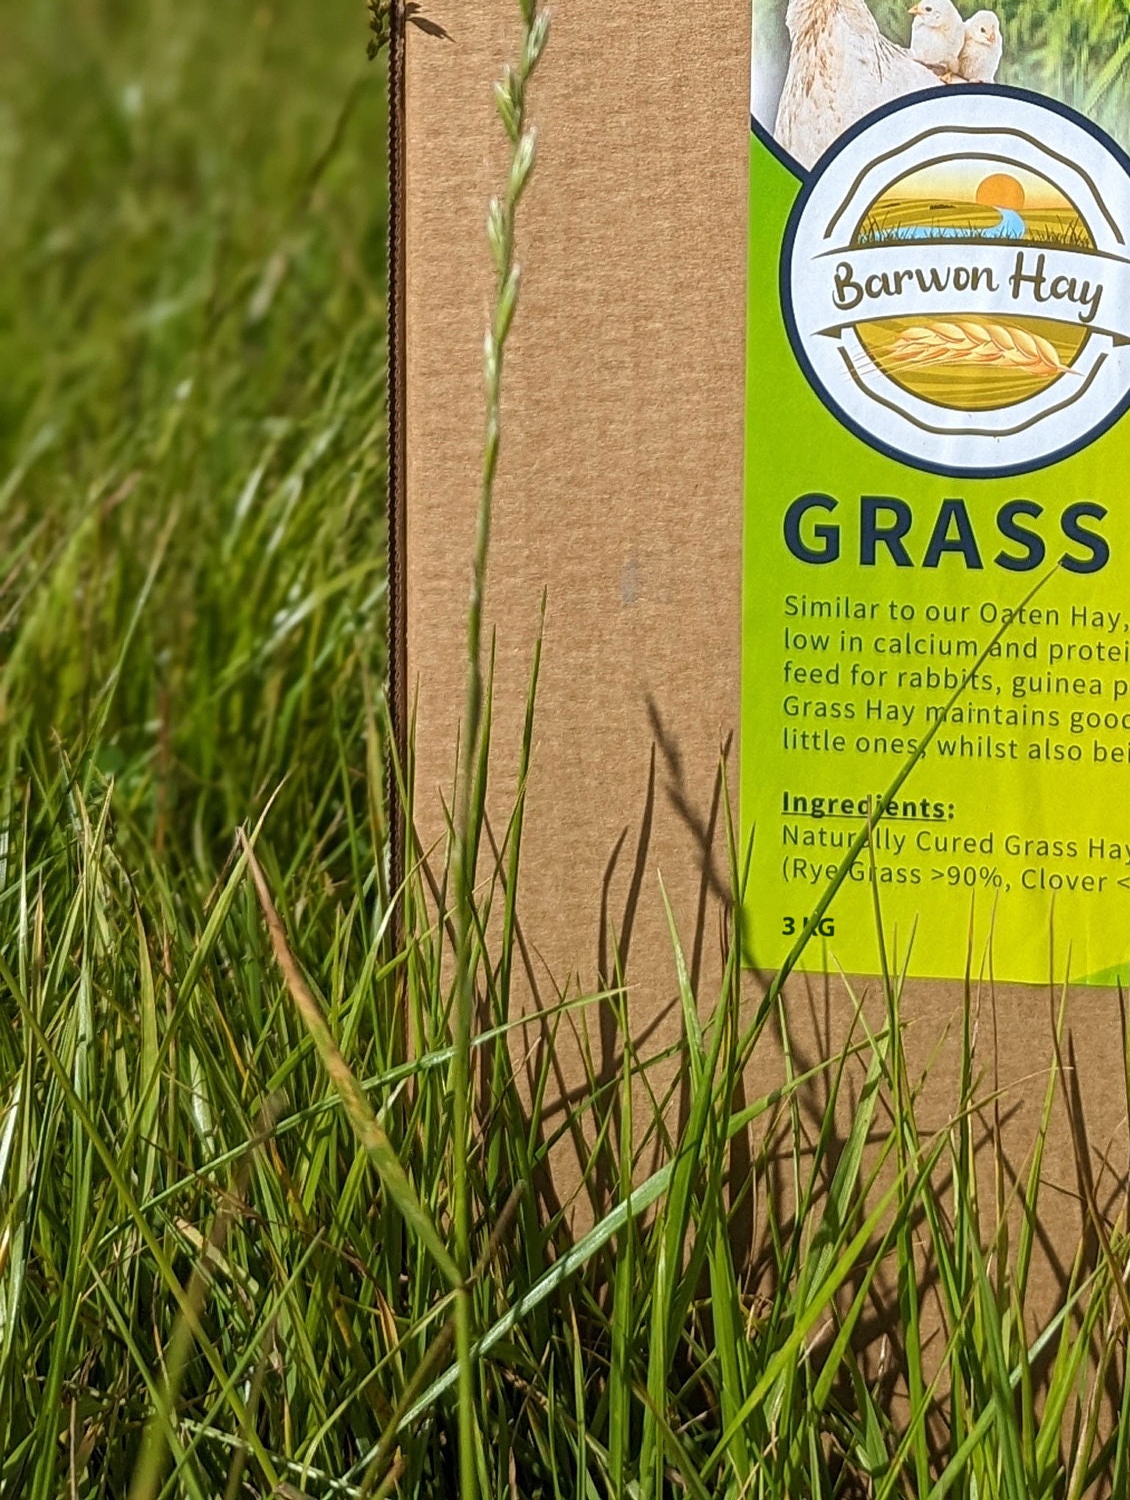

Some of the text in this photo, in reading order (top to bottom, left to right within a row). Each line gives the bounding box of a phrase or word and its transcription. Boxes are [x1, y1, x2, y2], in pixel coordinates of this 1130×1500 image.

[832, 251, 1103, 323] Barwon Hay
[783, 492, 1110, 573] GRASS
[785, 595, 880, 619] Similar
[889, 600, 915, 621] to
[925, 605, 970, 623] our
[980, 602, 1059, 625] Oaten
[1072, 605, 1130, 632] Hay,
[784, 628, 830, 651] low
[840, 631, 863, 652] in
[874, 633, 978, 656] calcium
[989, 637, 1038, 659] and
[784, 661, 840, 685] feed
[850, 664, 888, 687] for
[898, 666, 1003, 695] rabbits,
[1012, 672, 1102, 698] guinea
[784, 695, 856, 719] Grass
[866, 699, 915, 726] Hay
[925, 701, 1060, 727] maintains
[784, 728, 846, 752] little
[856, 737, 926, 759] ones,
[937, 735, 1018, 760] whilst
[1028, 738, 1082, 761] also
[916, 830, 994, 855] Cured
[1005, 834, 1078, 858] Grass
[783, 856, 838, 884] (Rye
[931, 866, 1011, 892] >90%,
[1021, 868, 1107, 892] Clover
[782, 916, 795, 935] 3
